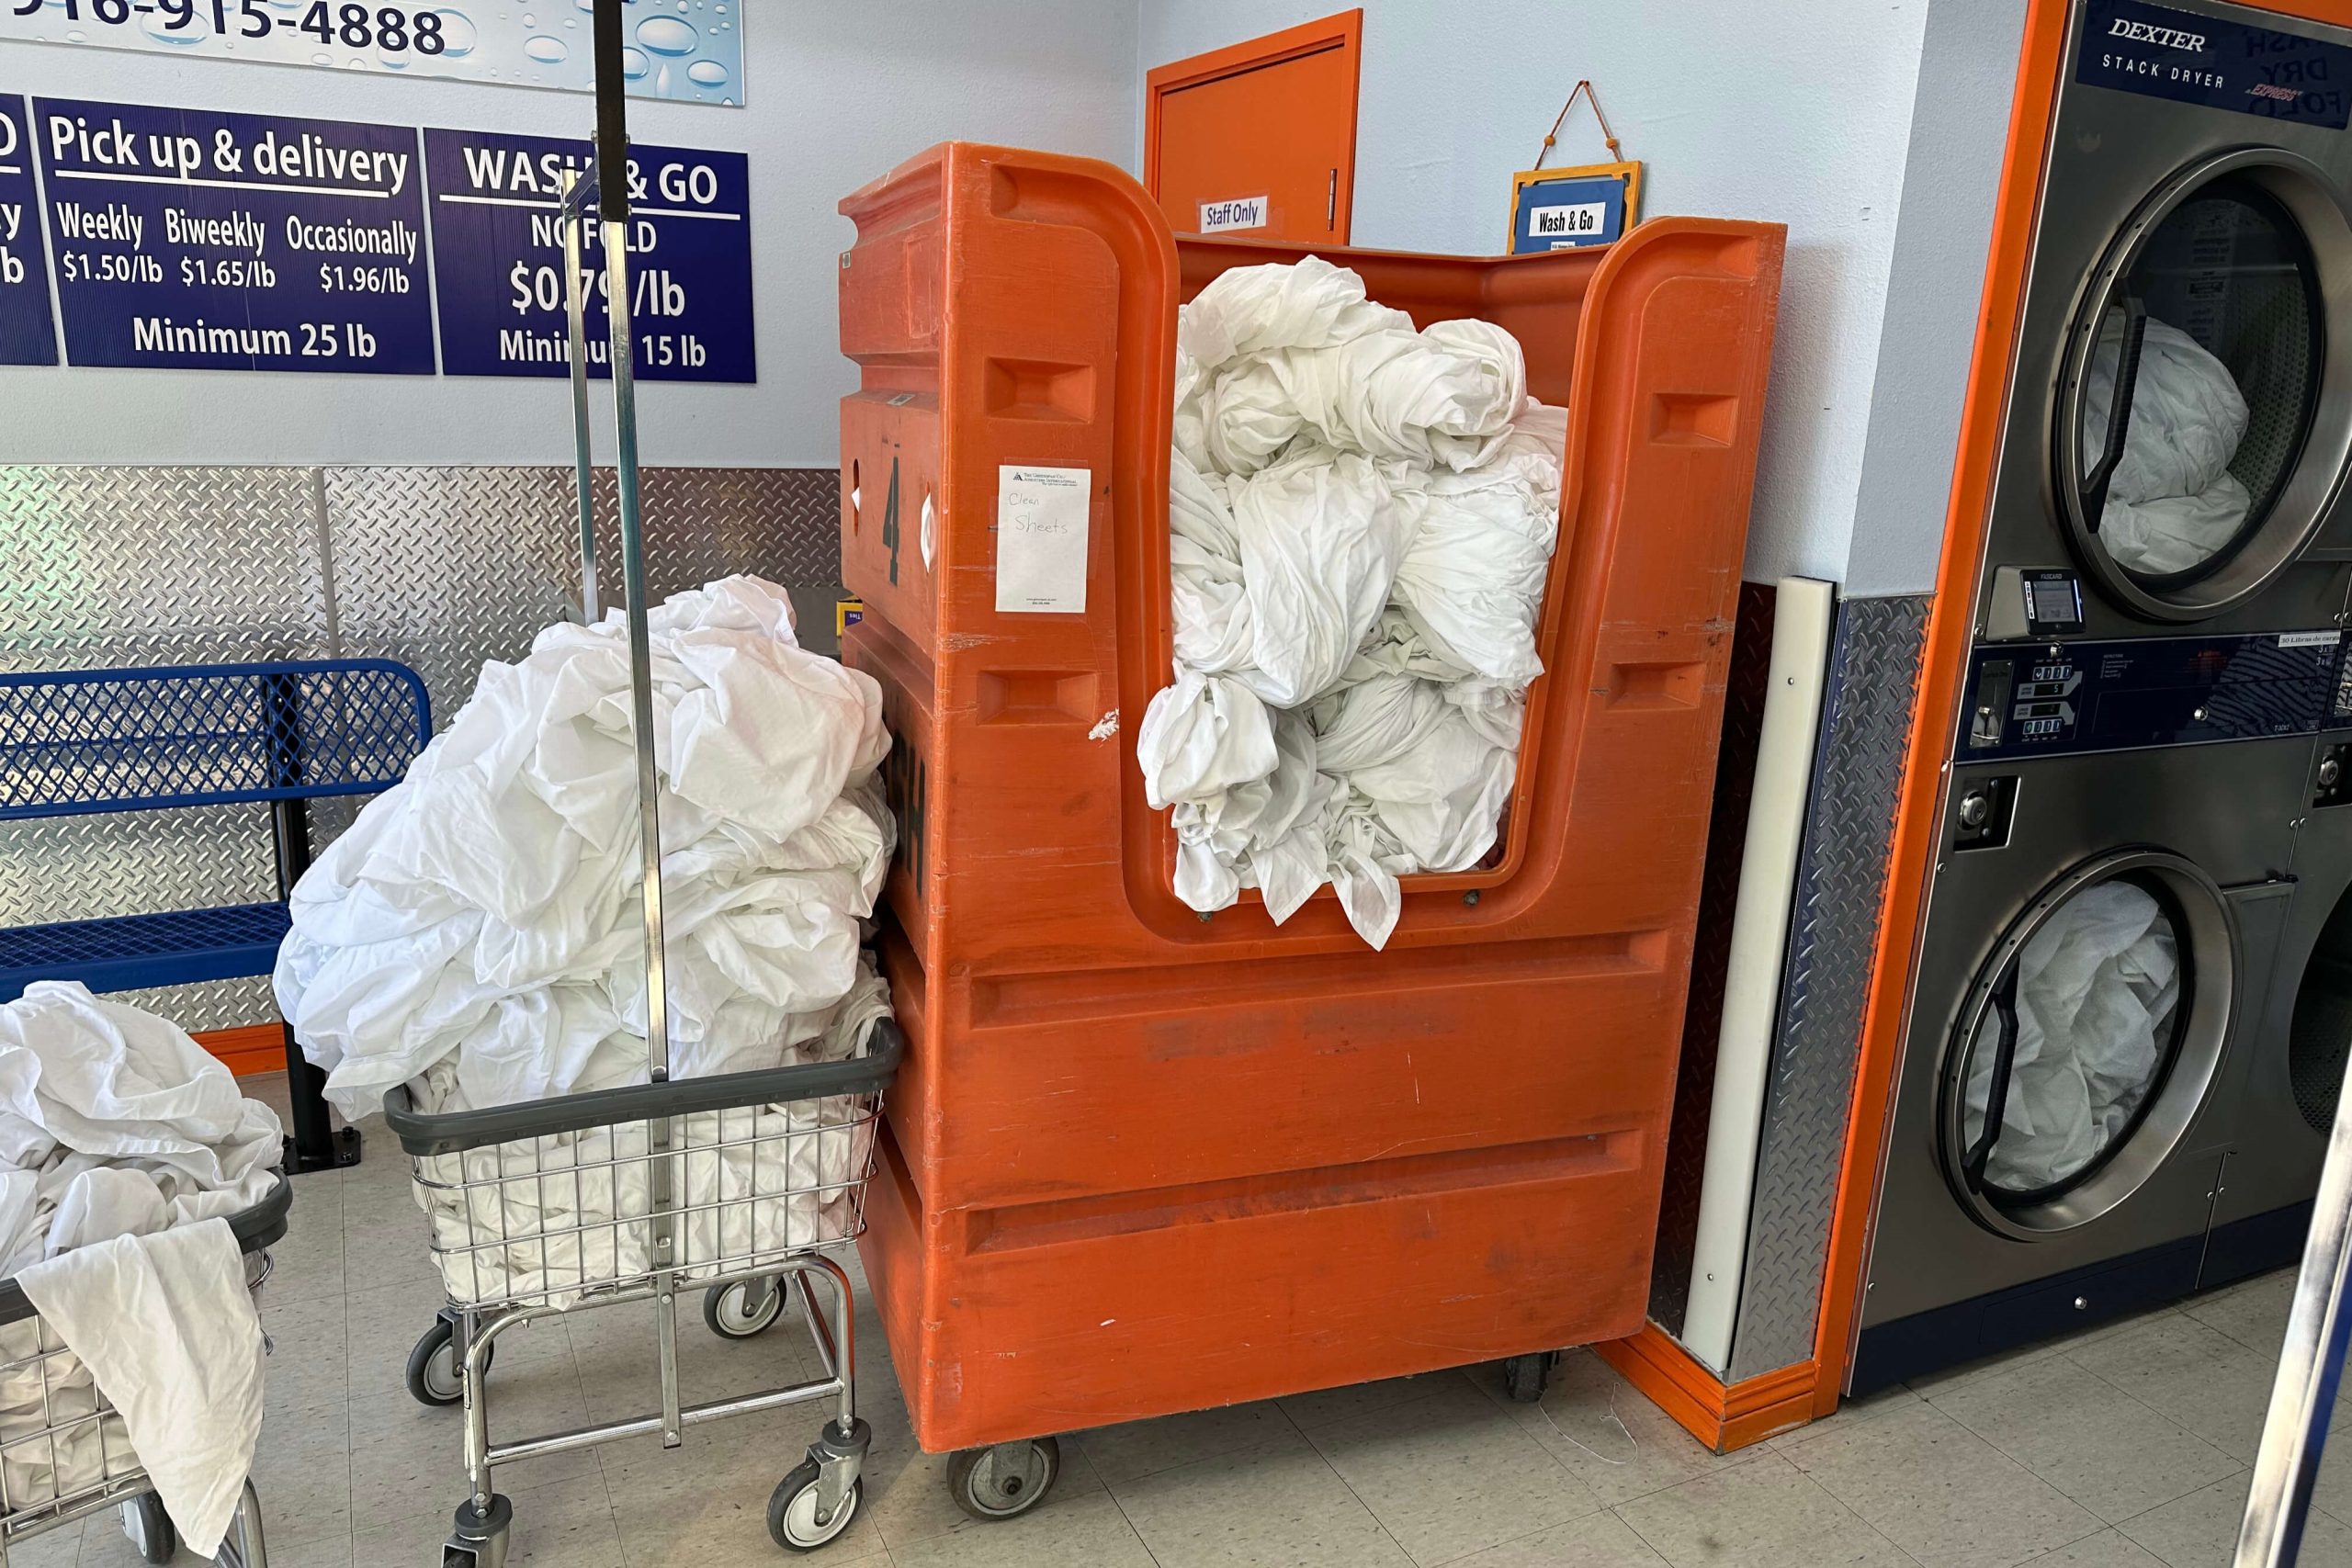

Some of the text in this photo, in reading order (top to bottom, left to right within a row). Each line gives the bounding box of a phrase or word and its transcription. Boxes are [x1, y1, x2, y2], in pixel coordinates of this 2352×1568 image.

[2108, 18, 2205, 52] DEXTER
[2102, 53, 2224, 89] STACK DRYER
[49, 116, 408, 196] Pick up & delivery
[659, 163, 718, 205] GO
[1206, 200, 1258, 226] Staff Only
[1539, 209, 1594, 232] Wash & Go
[56, 201, 417, 265] Weekly Biweekly Occasionally
[62, 250, 410, 294] $1.50/lb $1.65/lb $1.96/lb
[133, 317, 377, 358] Minimum 25 lb
[500, 329, 707, 367] Miniu 15 lb
[1009, 492, 1039, 505] Clean
[1015, 512, 1069, 535] Sheets
